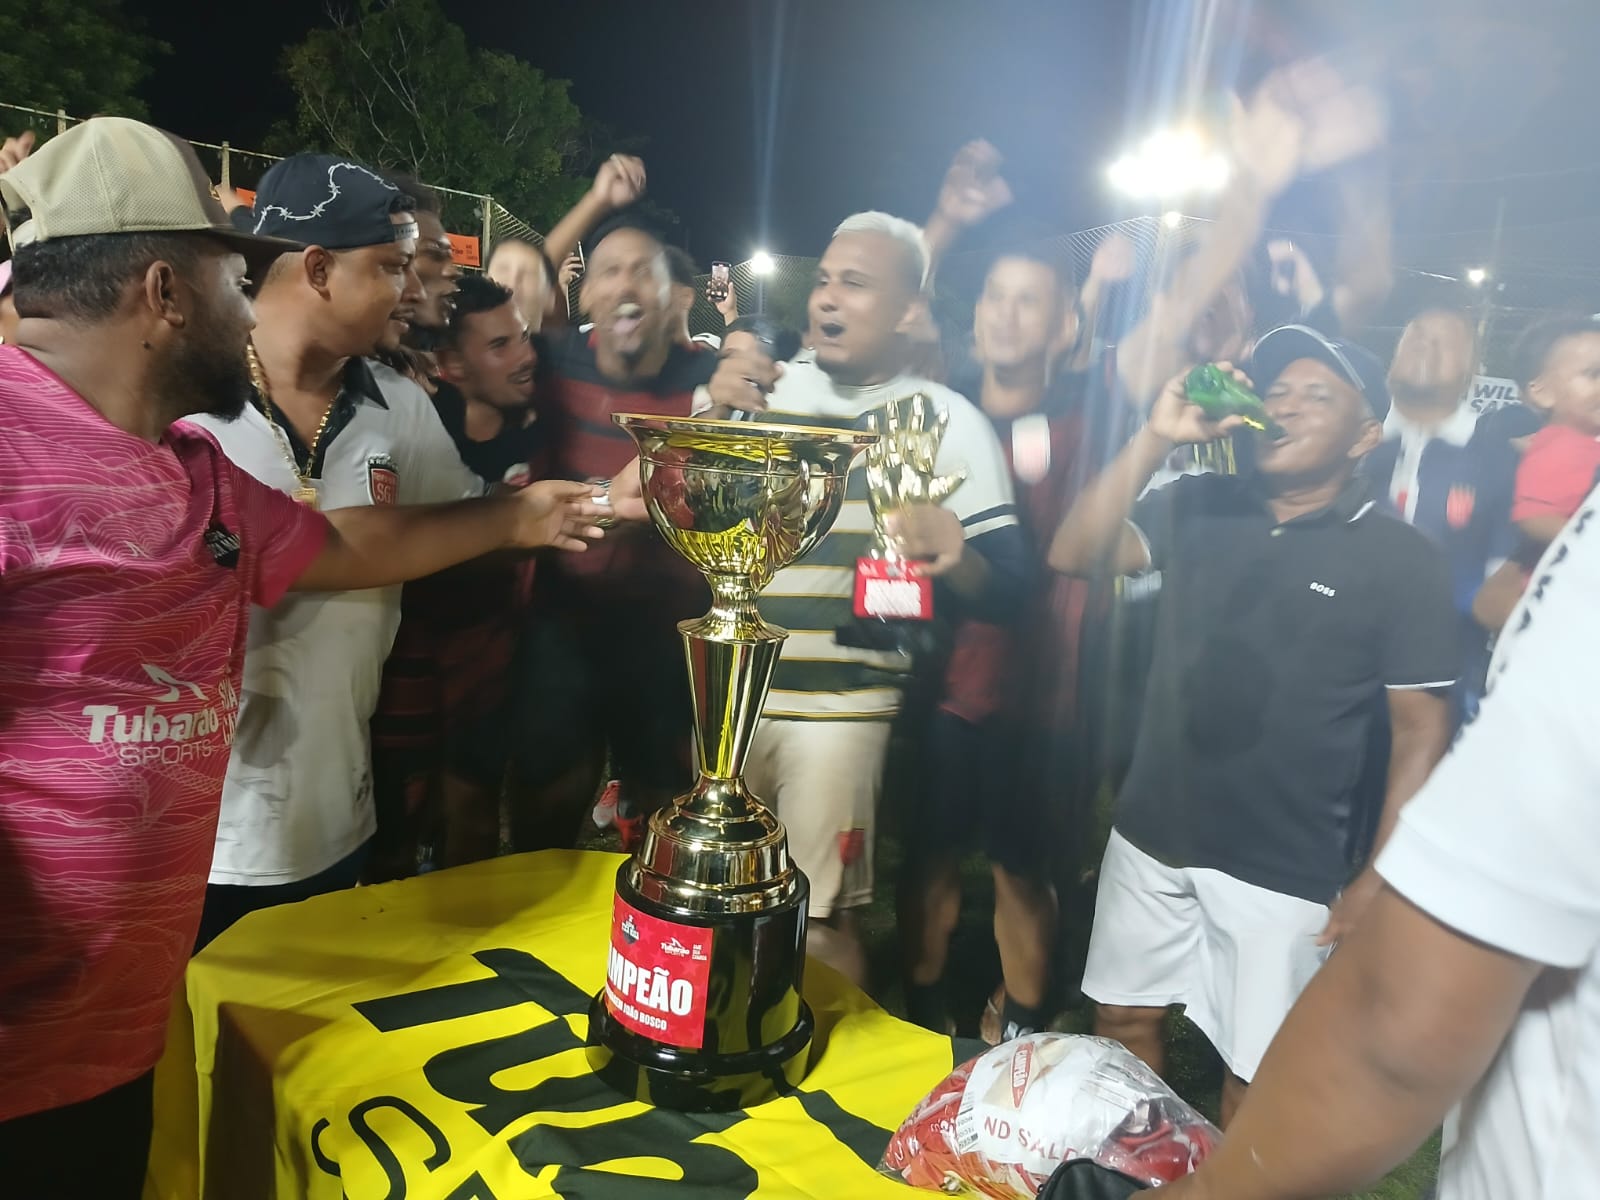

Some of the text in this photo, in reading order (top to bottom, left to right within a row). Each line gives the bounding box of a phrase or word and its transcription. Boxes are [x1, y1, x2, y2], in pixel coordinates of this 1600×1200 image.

[1309, 581, 1336, 597] BOSS
[119, 738, 212, 767] SPORTS
[639, 1010, 668, 1031] BOSCO
